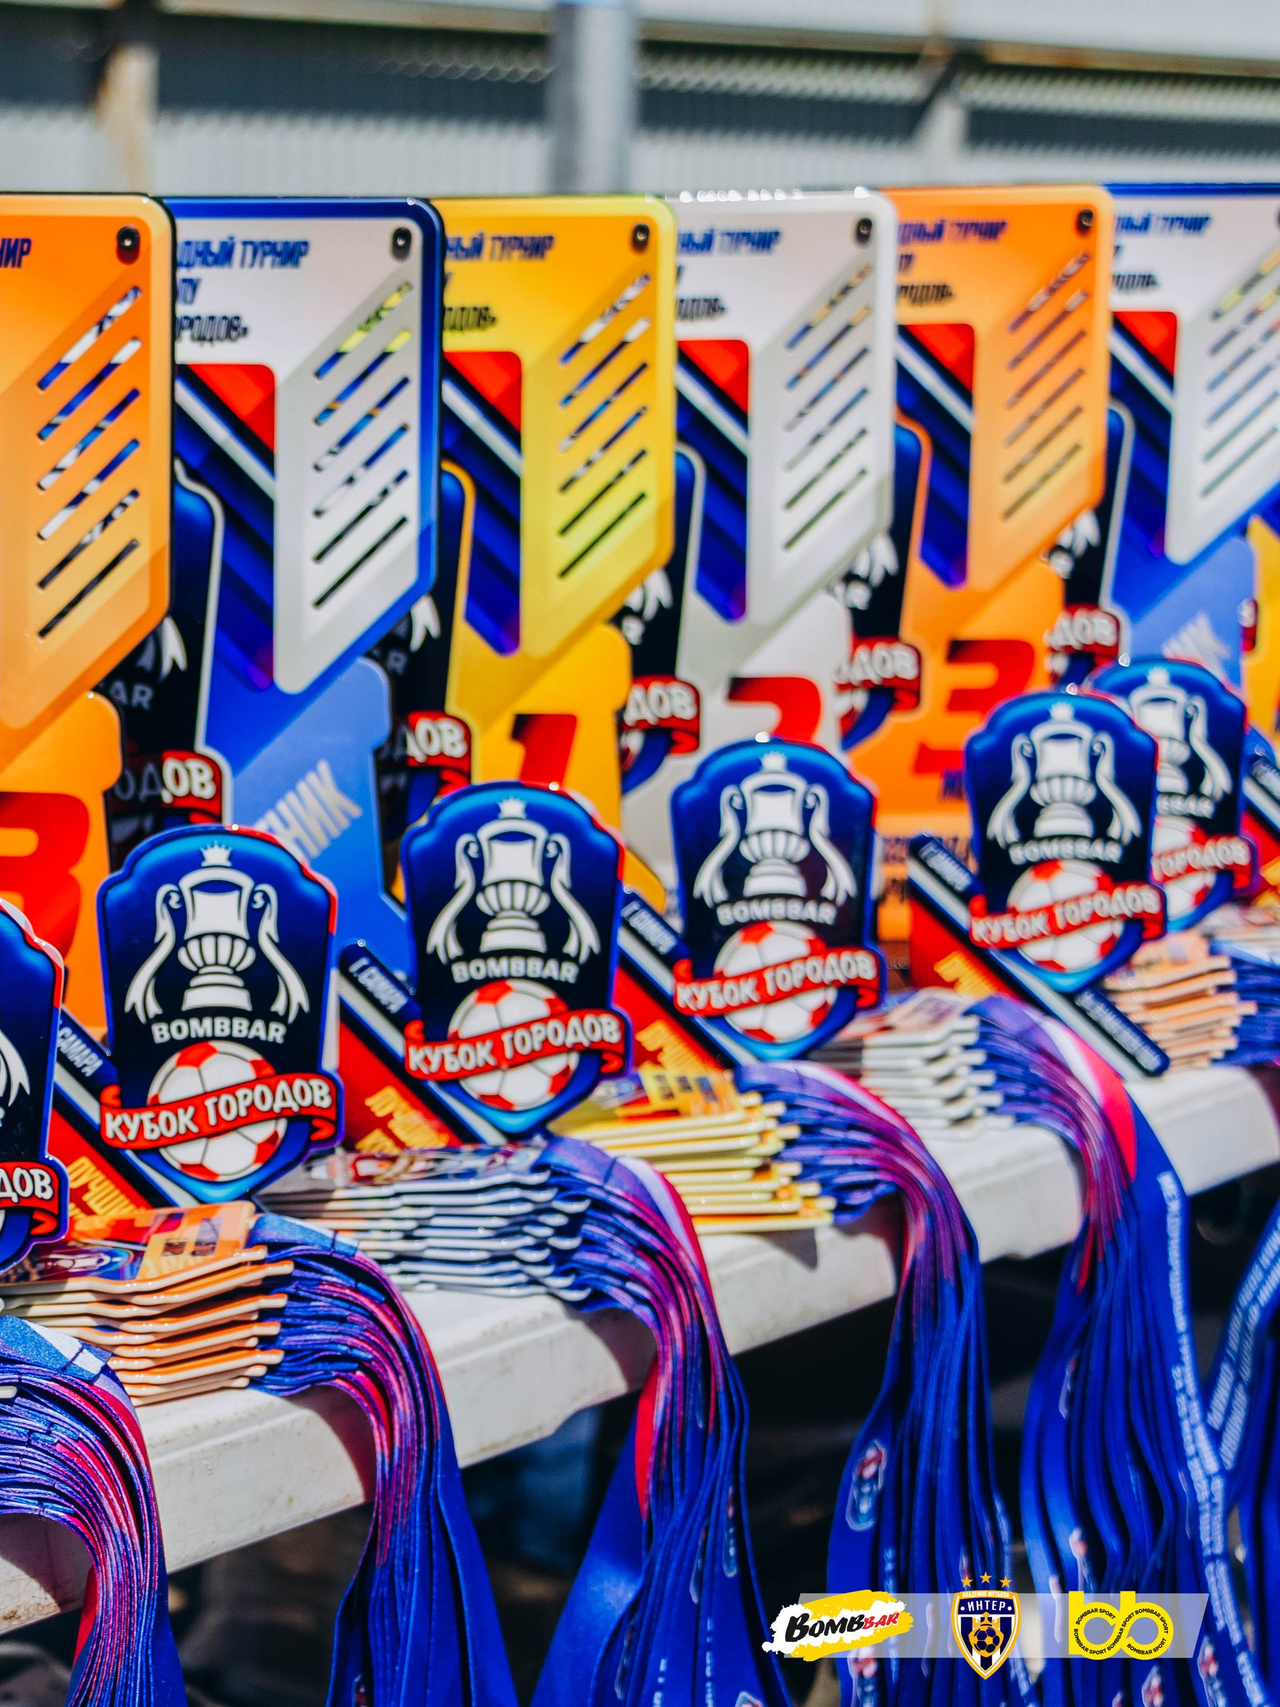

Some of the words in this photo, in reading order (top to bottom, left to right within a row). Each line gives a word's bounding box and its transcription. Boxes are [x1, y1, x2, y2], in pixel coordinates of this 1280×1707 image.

[451, 956, 579, 984] BOMBBAR
[763, 951, 877, 996] ГОРОДОВ
[151, 1017, 287, 1044] BOMBBAR
[408, 1040, 497, 1074] КУБОК
[501, 1014, 622, 1059] ГОРОДОВ
[105, 1106, 199, 1143] КУБОК
[204, 1078, 332, 1126] ГОРОДОВ
